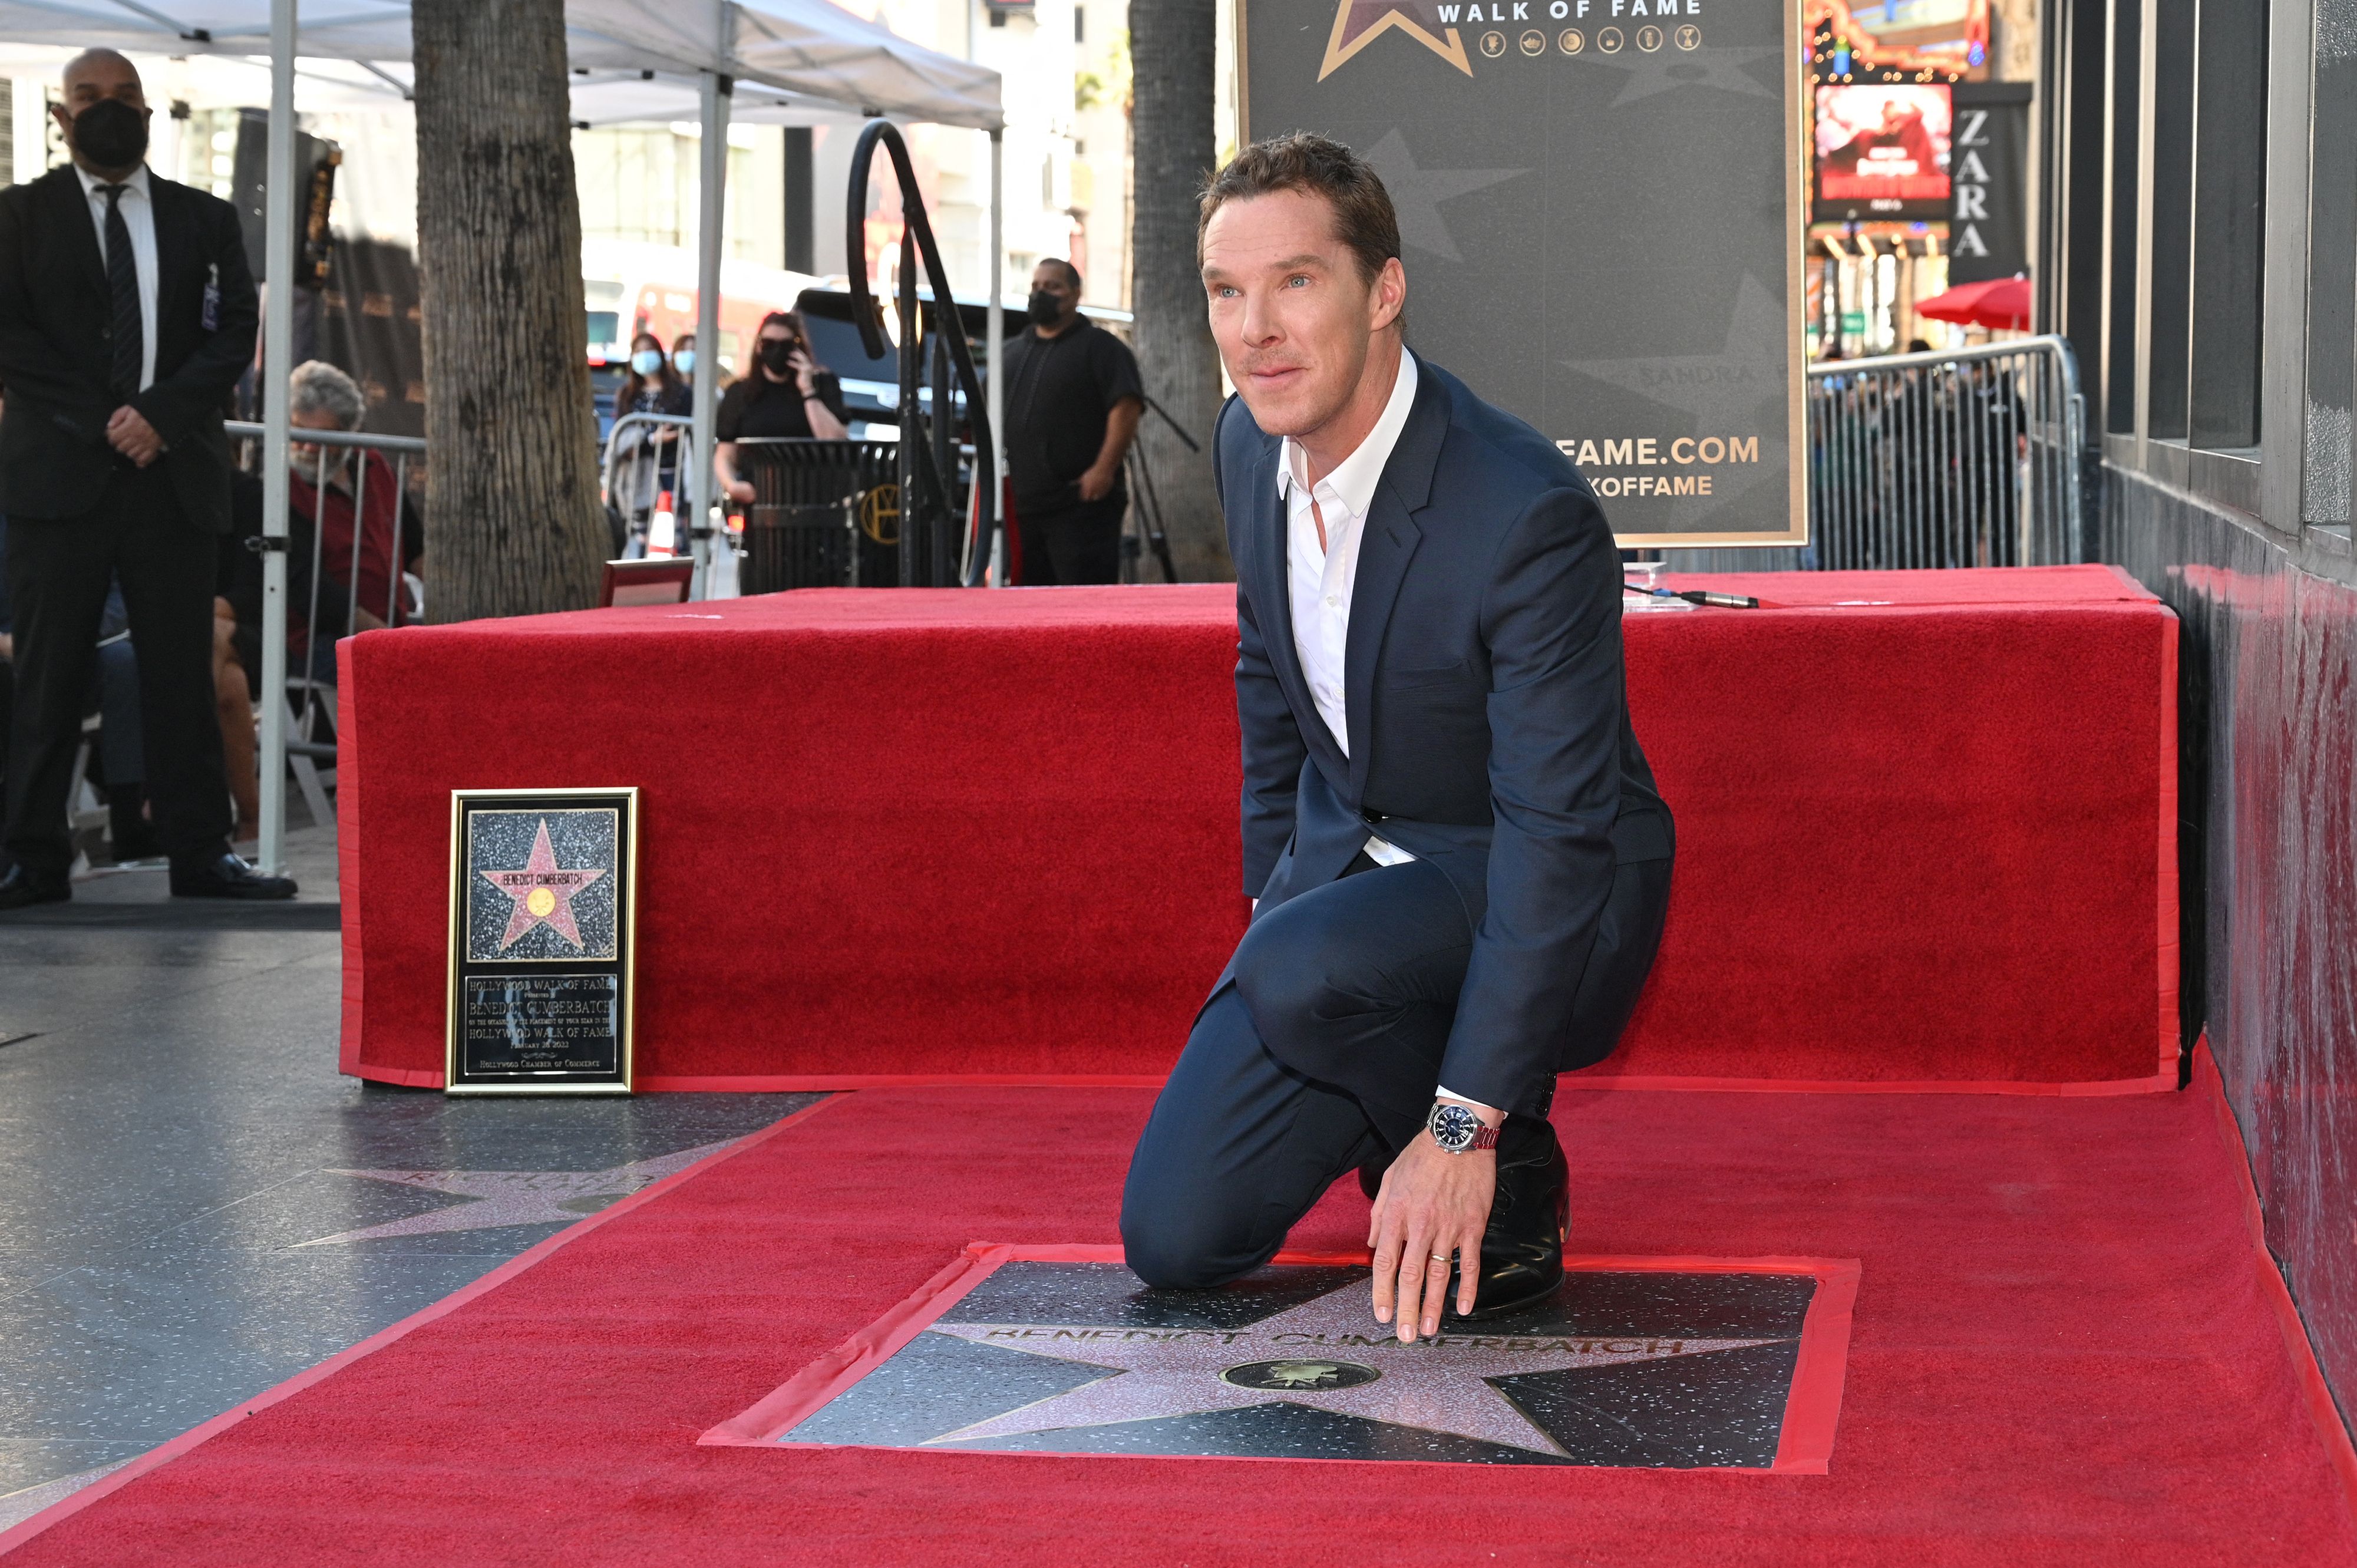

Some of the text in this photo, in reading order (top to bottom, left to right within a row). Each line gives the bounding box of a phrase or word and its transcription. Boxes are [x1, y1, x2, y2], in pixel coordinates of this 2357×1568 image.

[1438, 0, 1701, 23] WALK OF FAME
[1953, 110, 1992, 258] ZARA
[1556, 436, 1758, 466] FAME.COM
[1586, 476, 1712, 497] KOFFAME
[503, 873, 583, 885] BENEDICT CUMBERBATCH
[470, 981, 530, 991] HOLLYWOOD
[534, 979, 565, 990] WALK
[567, 979, 580, 990] OF
[470, 1000, 611, 1015] BENEDICT CUMBERBATCH
[567, 1027, 580, 1037] OF
[583, 1026, 612, 1037] FAME
[985, 1328, 1685, 1354] BENEDICT CUMBERBATCH
